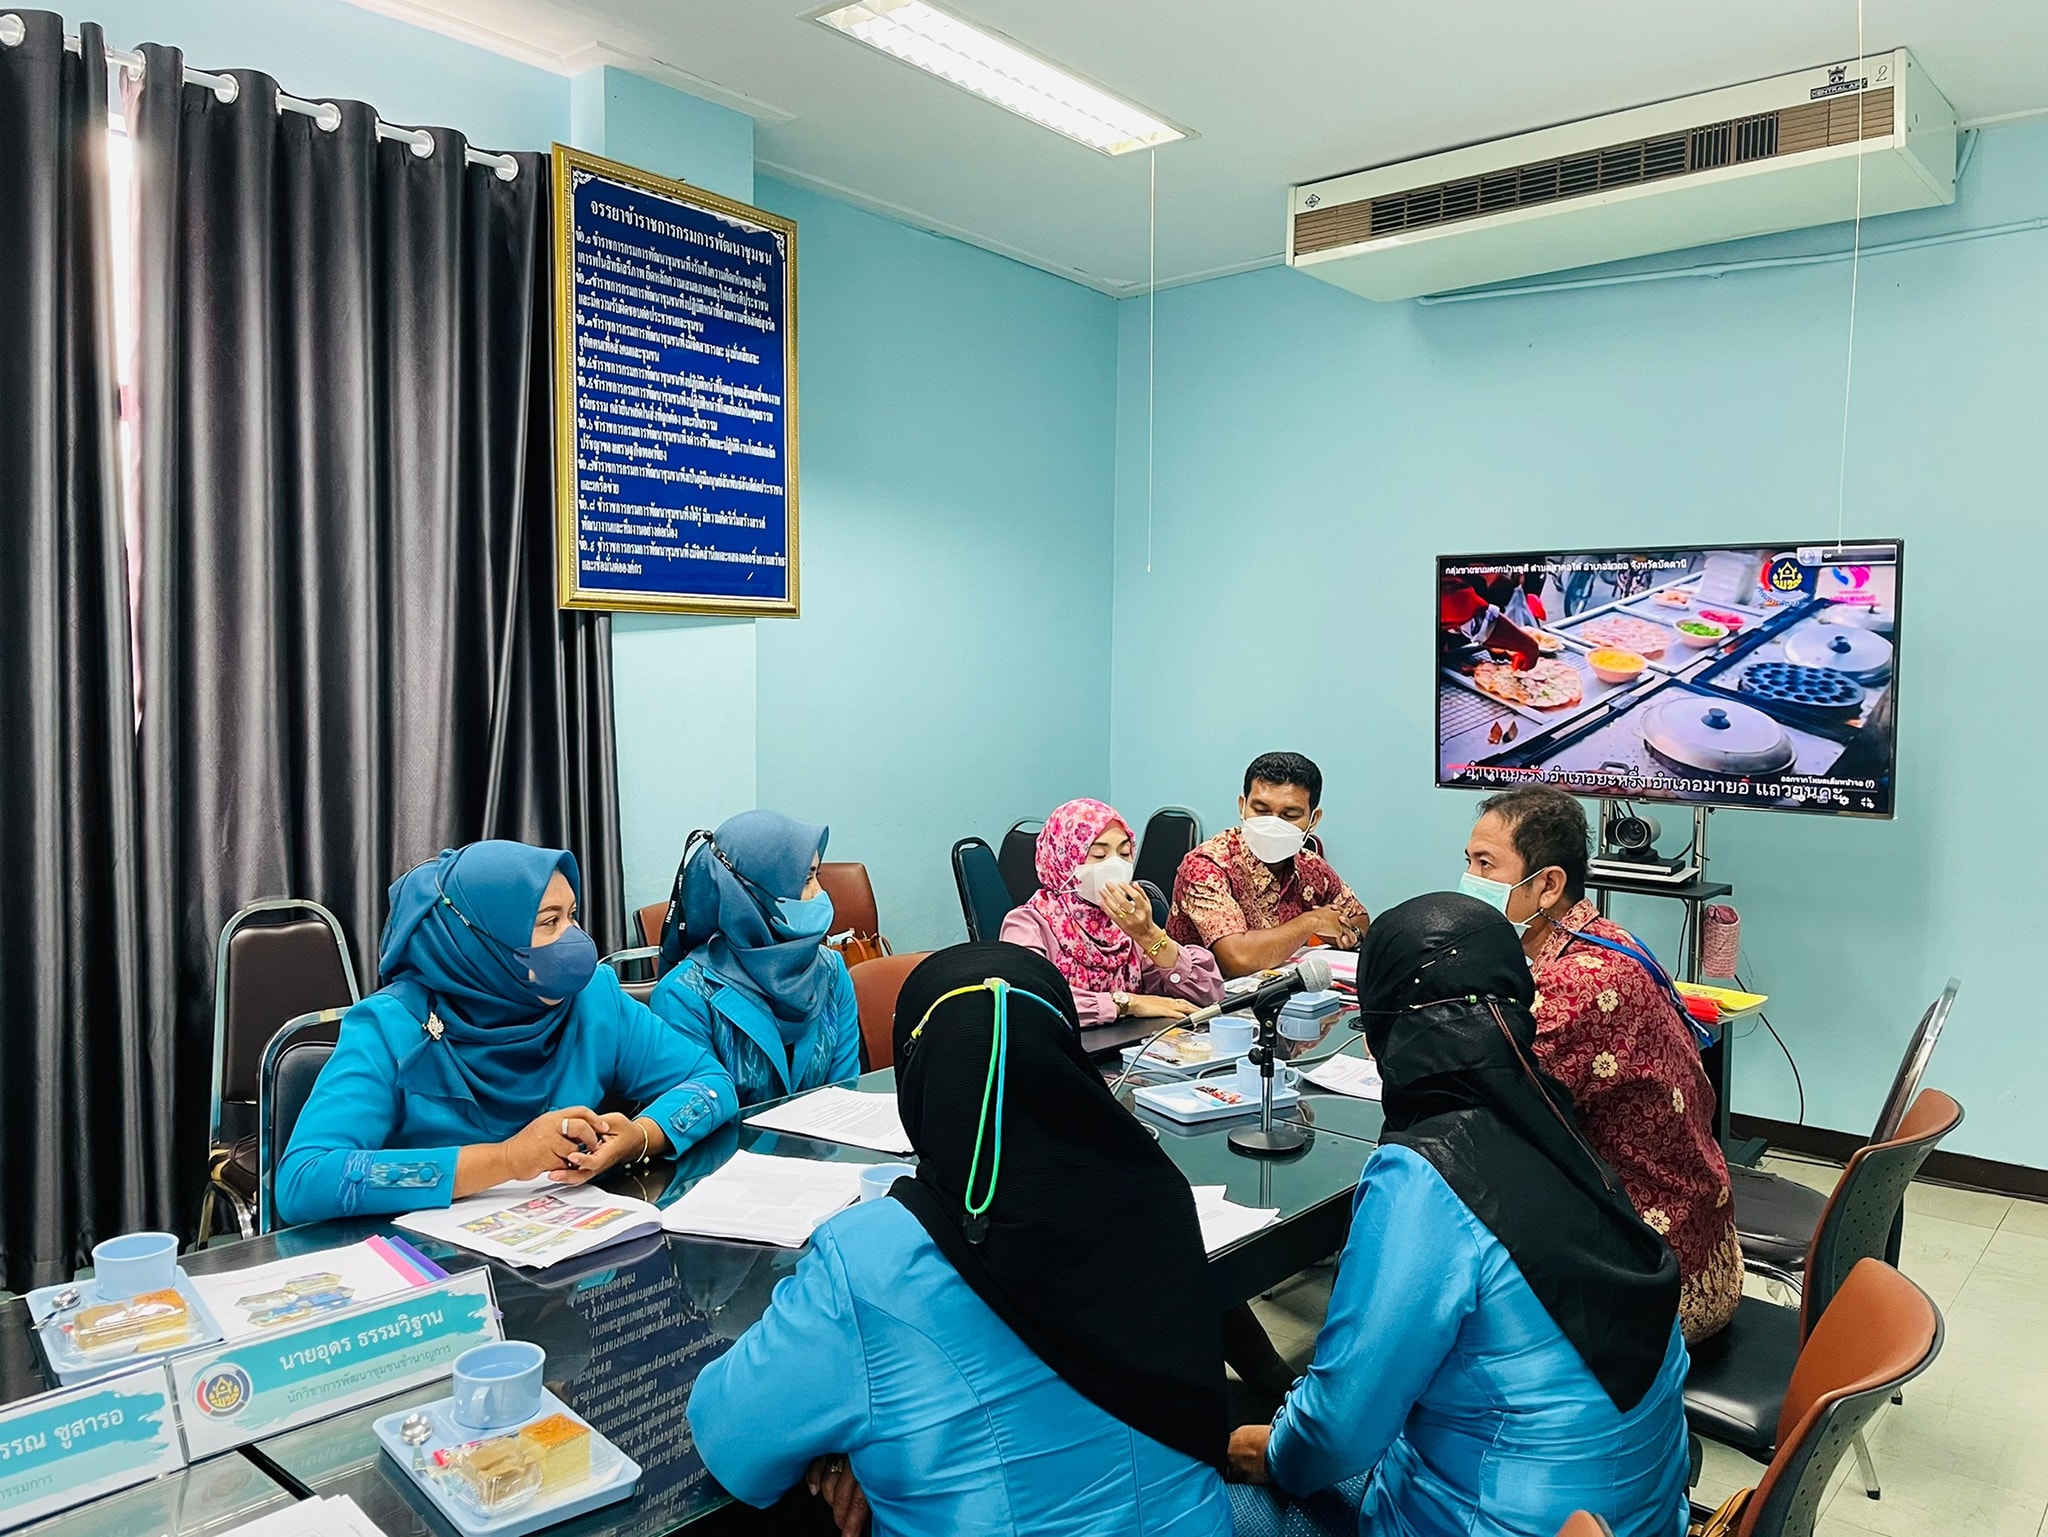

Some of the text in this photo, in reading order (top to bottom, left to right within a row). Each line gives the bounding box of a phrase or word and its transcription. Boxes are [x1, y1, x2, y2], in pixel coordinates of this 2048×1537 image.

[590, 199, 772, 266] จรรยาข้าราชการกรมการพัฒนาชุมชน
[1550, 764, 1646, 789] อำเภอยะหริ่ง
[279, 1308, 444, 1370] นายอุดร ธรรมวิฐาน
[287, 1343, 452, 1404] นักวิชาการพัฒนาชุมชนชำนาญการ
